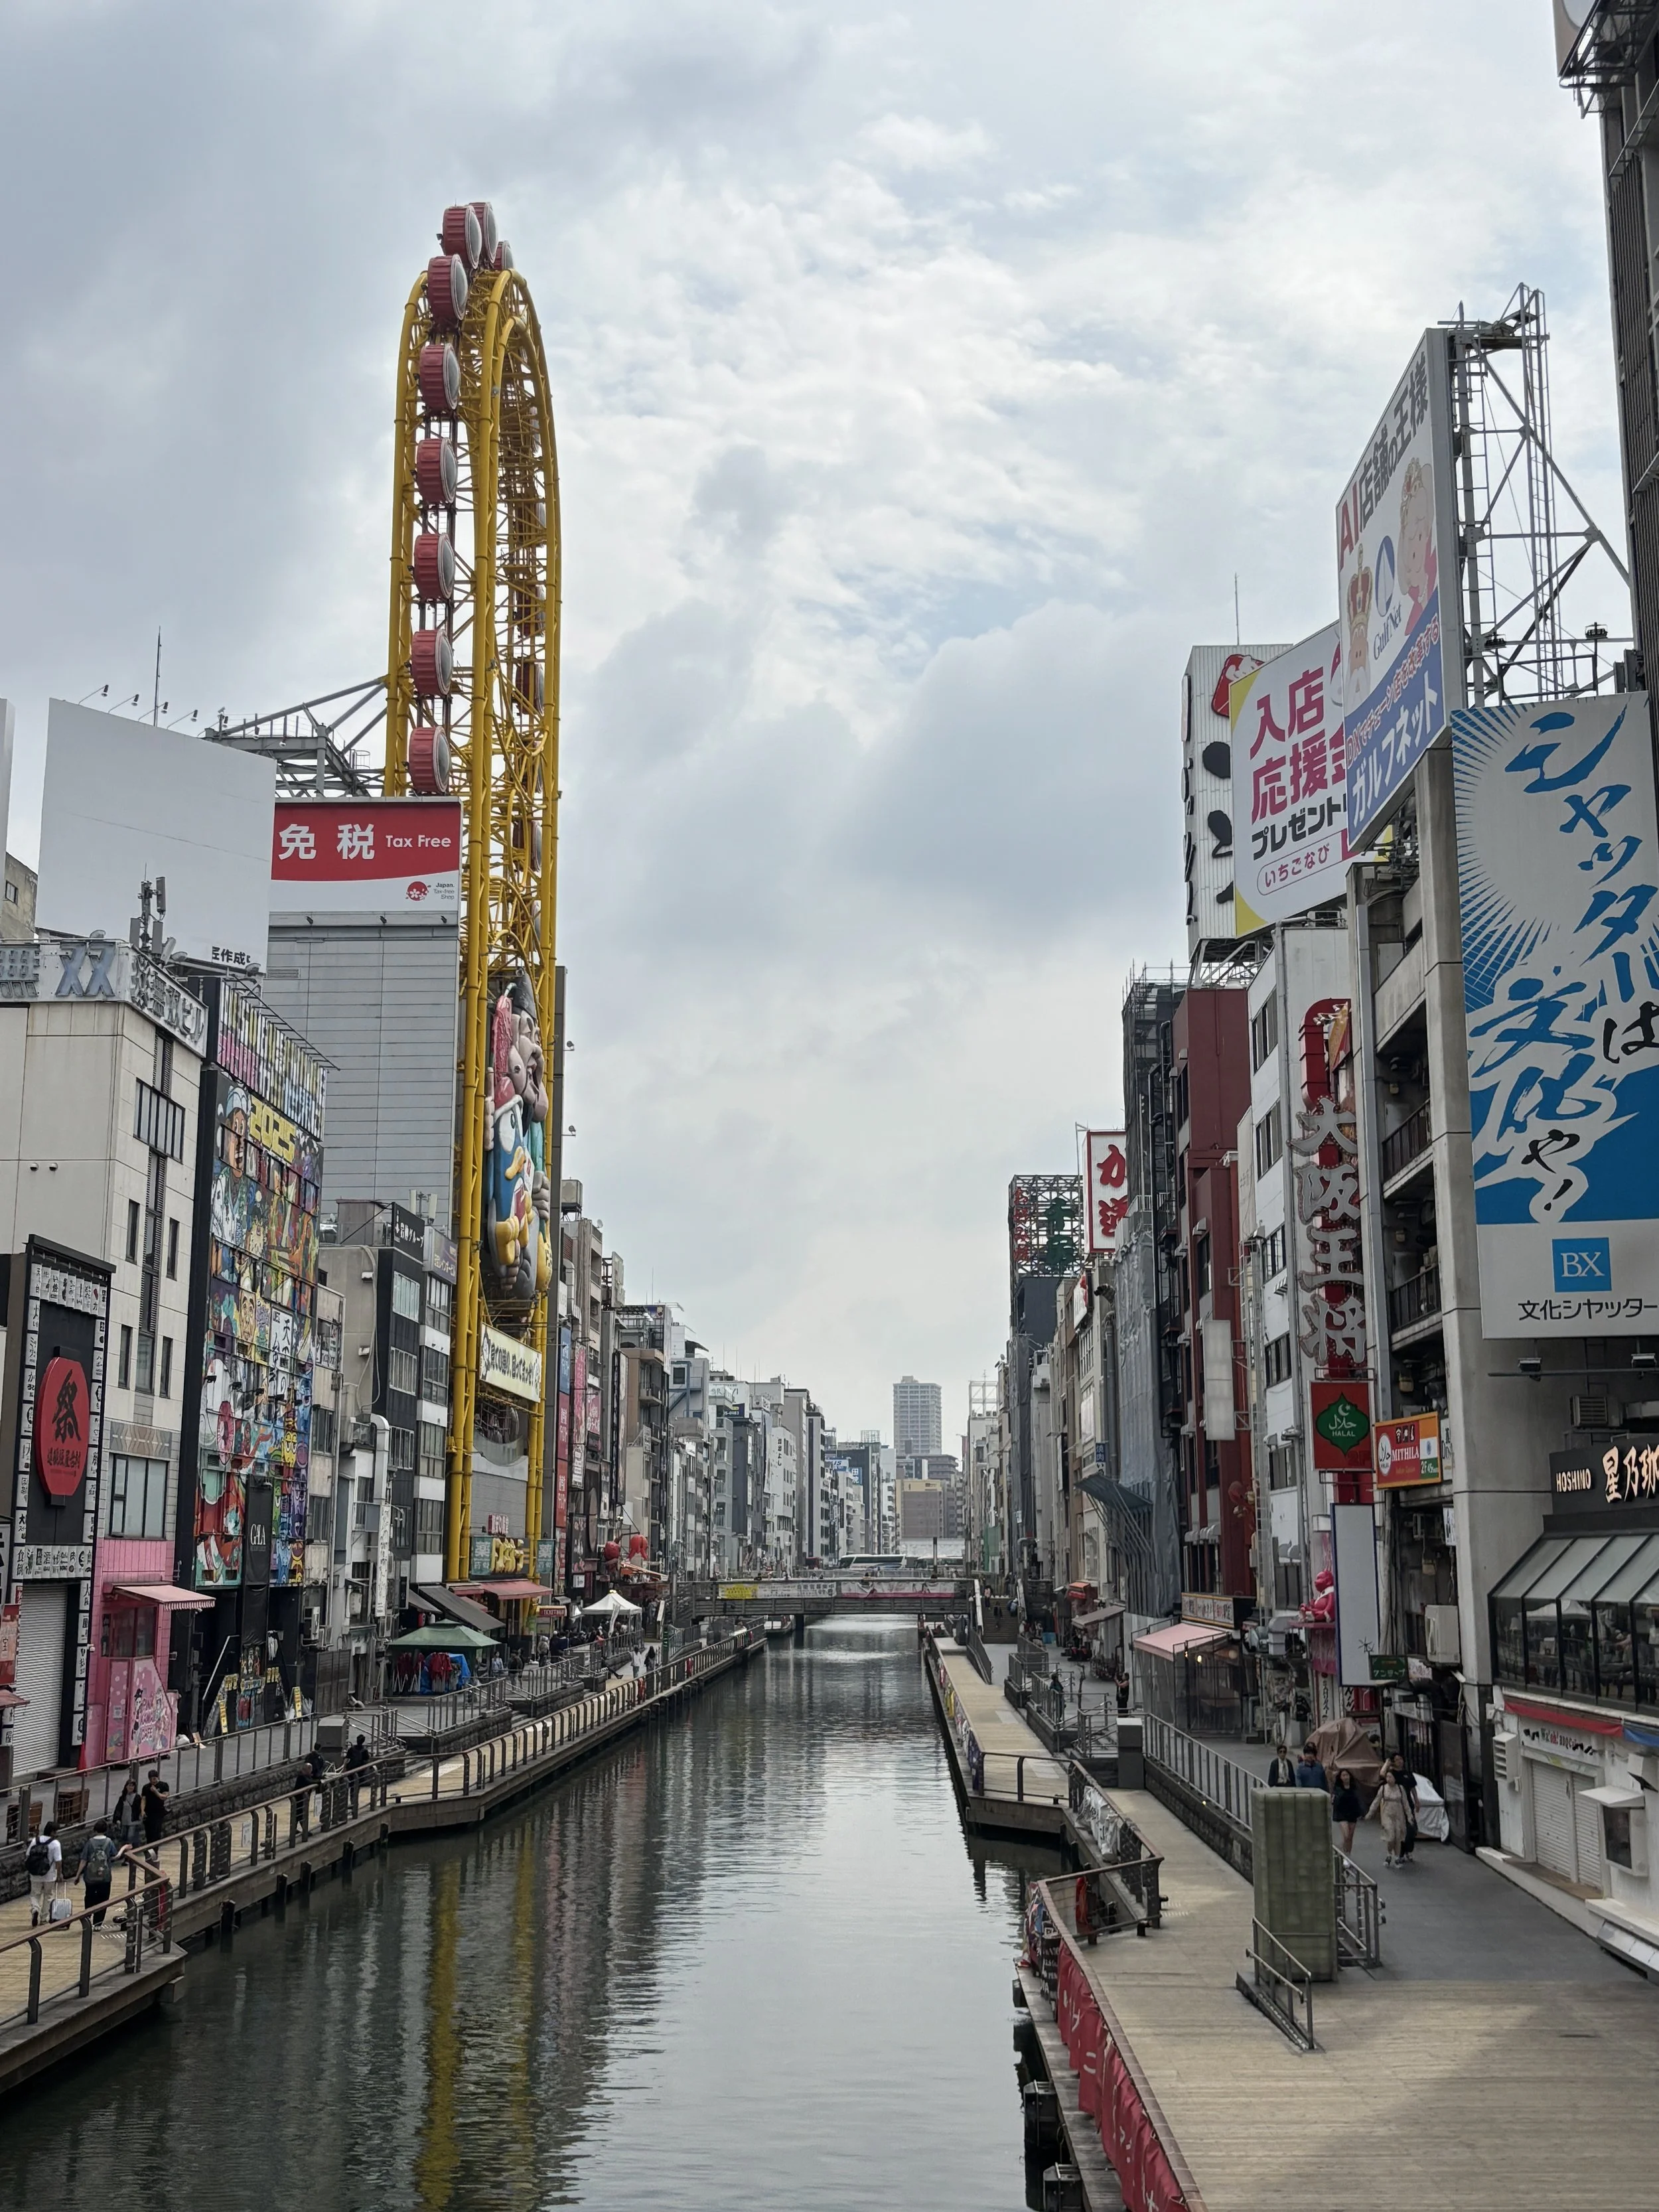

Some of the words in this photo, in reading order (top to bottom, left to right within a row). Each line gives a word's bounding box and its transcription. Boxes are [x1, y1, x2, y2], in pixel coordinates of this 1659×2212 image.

[1250, 665, 1325, 761] 入店
[1352, 670, 1438, 830] ガルフネット
[386, 835, 413, 848] Tax
[417, 835, 451, 848] Free
[1251, 794, 1346, 861] プレゼント
[1264, 843, 1331, 888] いちごなび
[248, 1095, 297, 1165] 2025
[1289, 1097, 1367, 1366] 大阪王将
[1561, 1252, 1605, 1277] BX
[1329, 1414, 1357, 1430] حلال
[1392, 1446, 1419, 1462] MITHILA
[1420, 1460, 1427, 1474] 2F
[1556, 1468, 1591, 1493] HOSHINO
